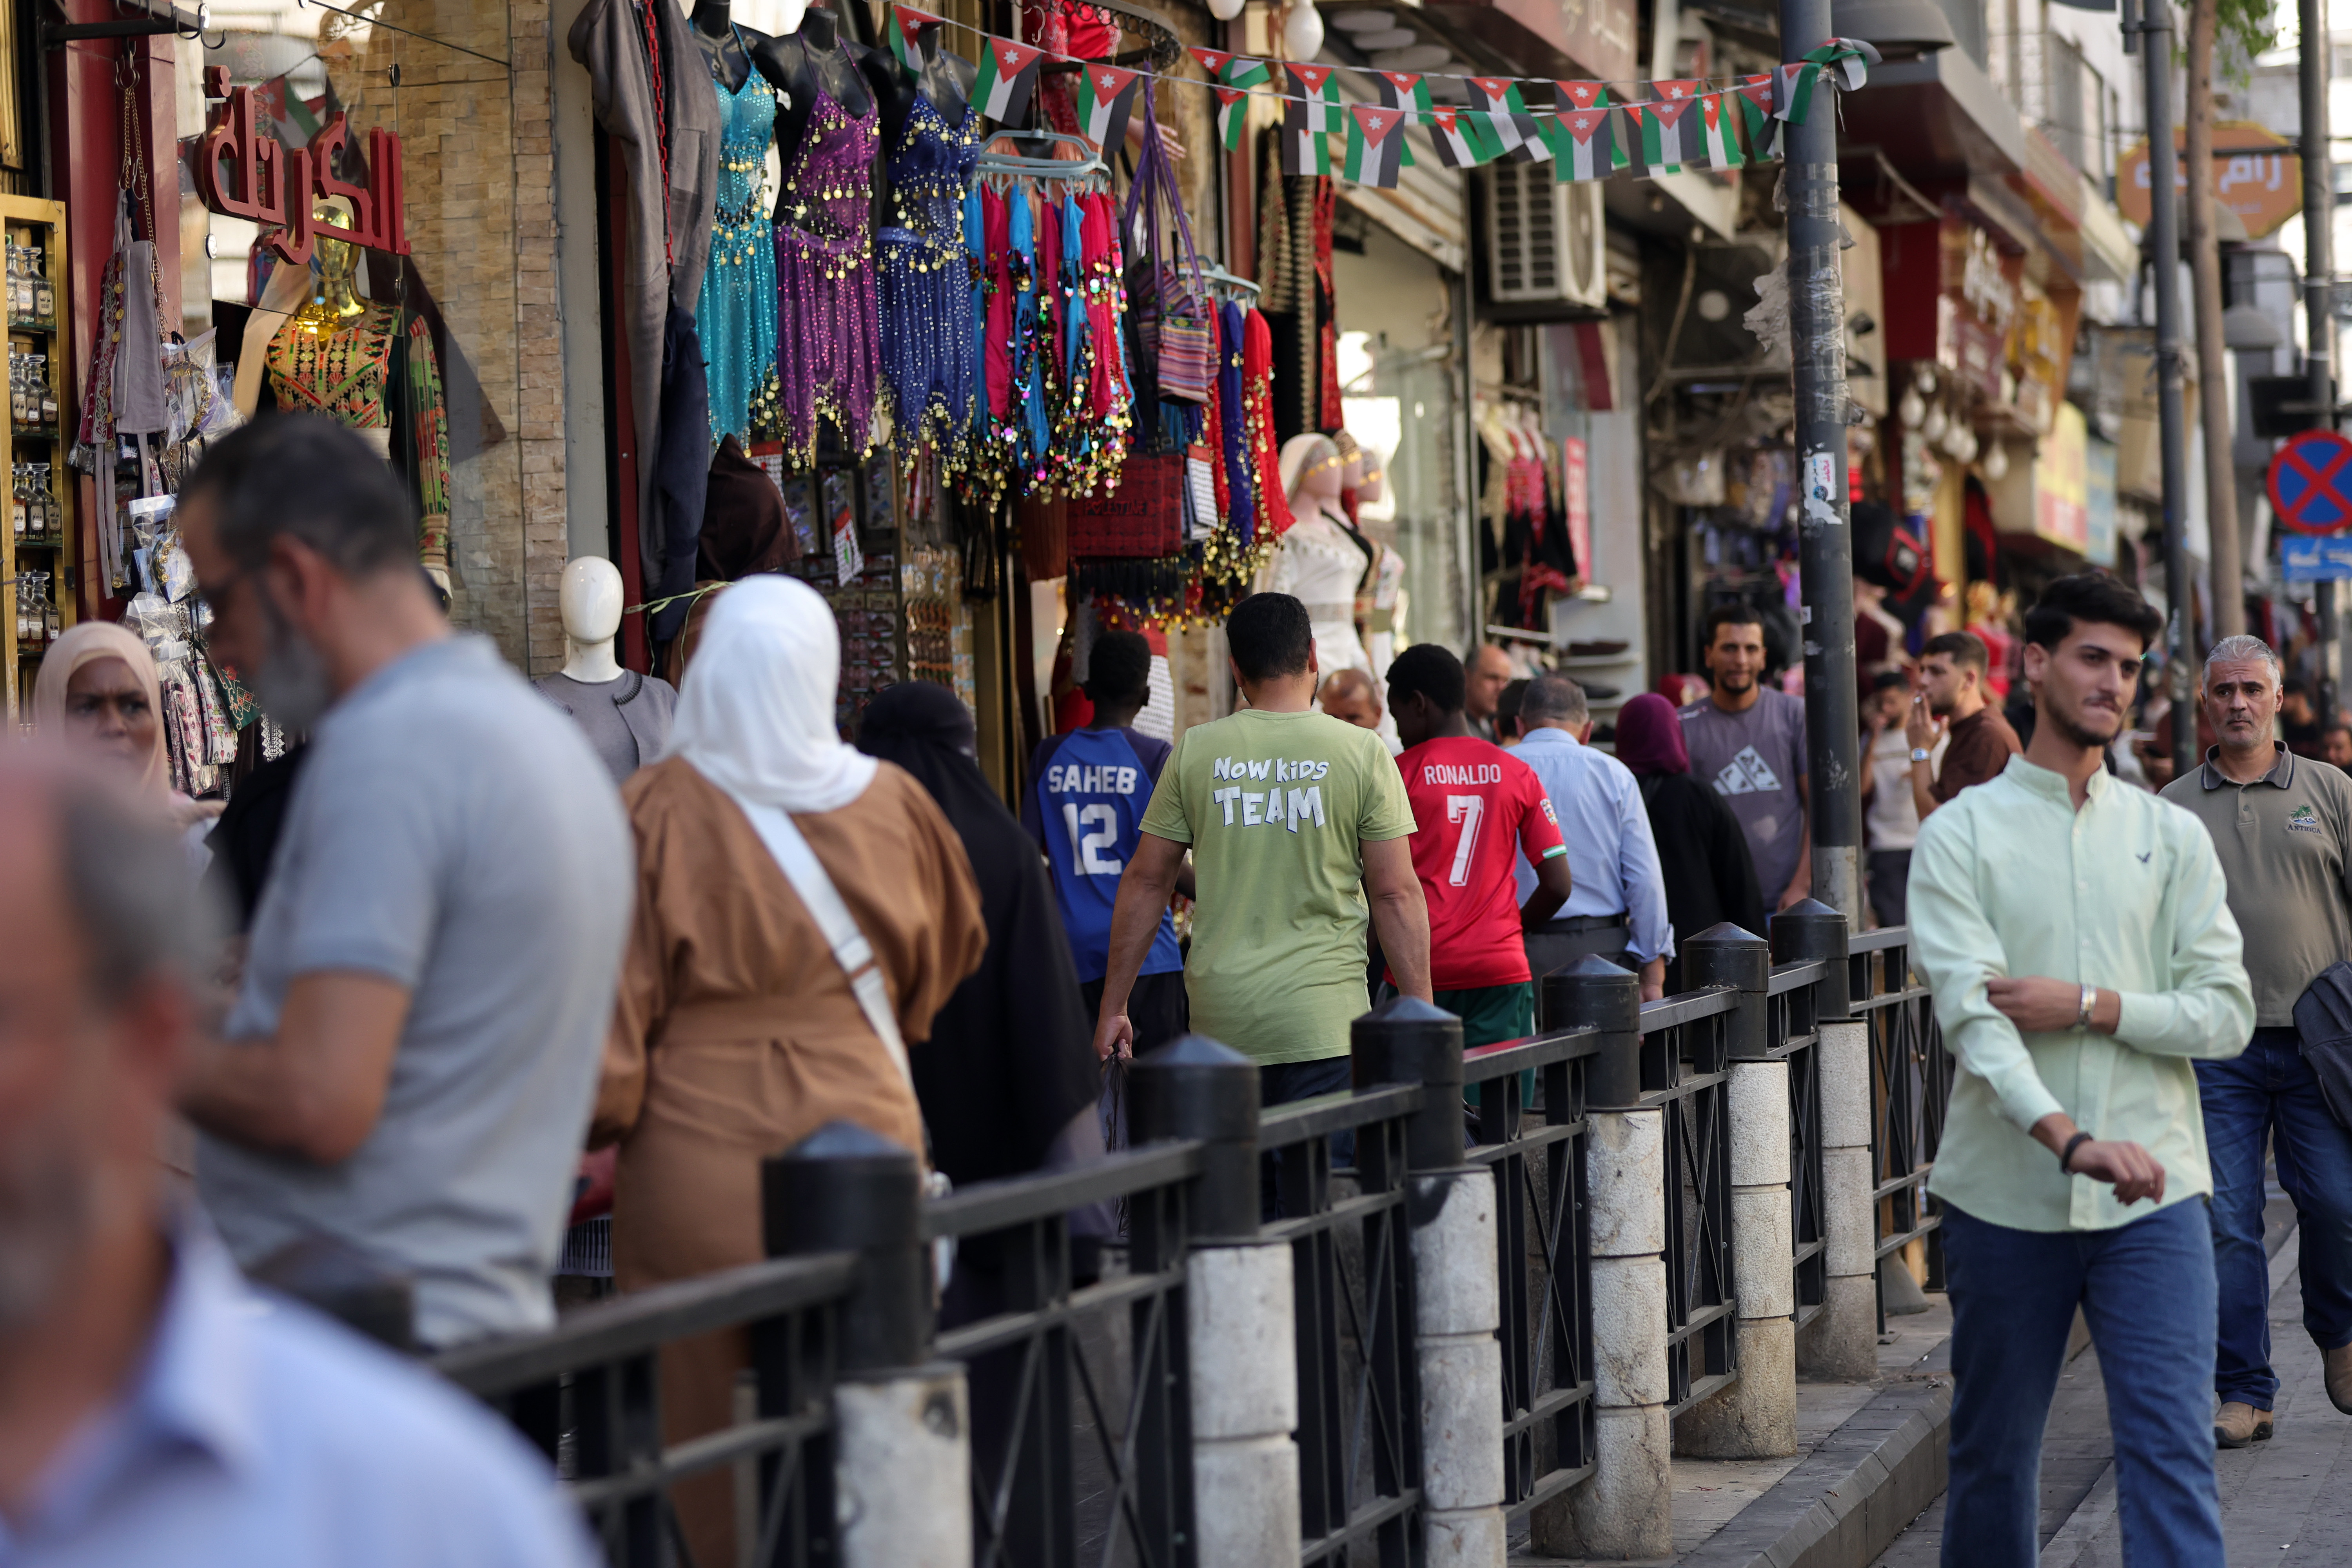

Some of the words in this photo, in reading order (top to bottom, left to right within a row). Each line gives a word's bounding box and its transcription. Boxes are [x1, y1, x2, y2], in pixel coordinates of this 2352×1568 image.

[1048, 764, 1138, 795] SAHEB
[1424, 764, 1501, 785] RONALDO
[1213, 786, 1325, 833] TEAM
[1062, 802, 1122, 876] 12
[1446, 795, 1484, 887] 7
[2287, 824, 2322, 835] ANTIGUA
